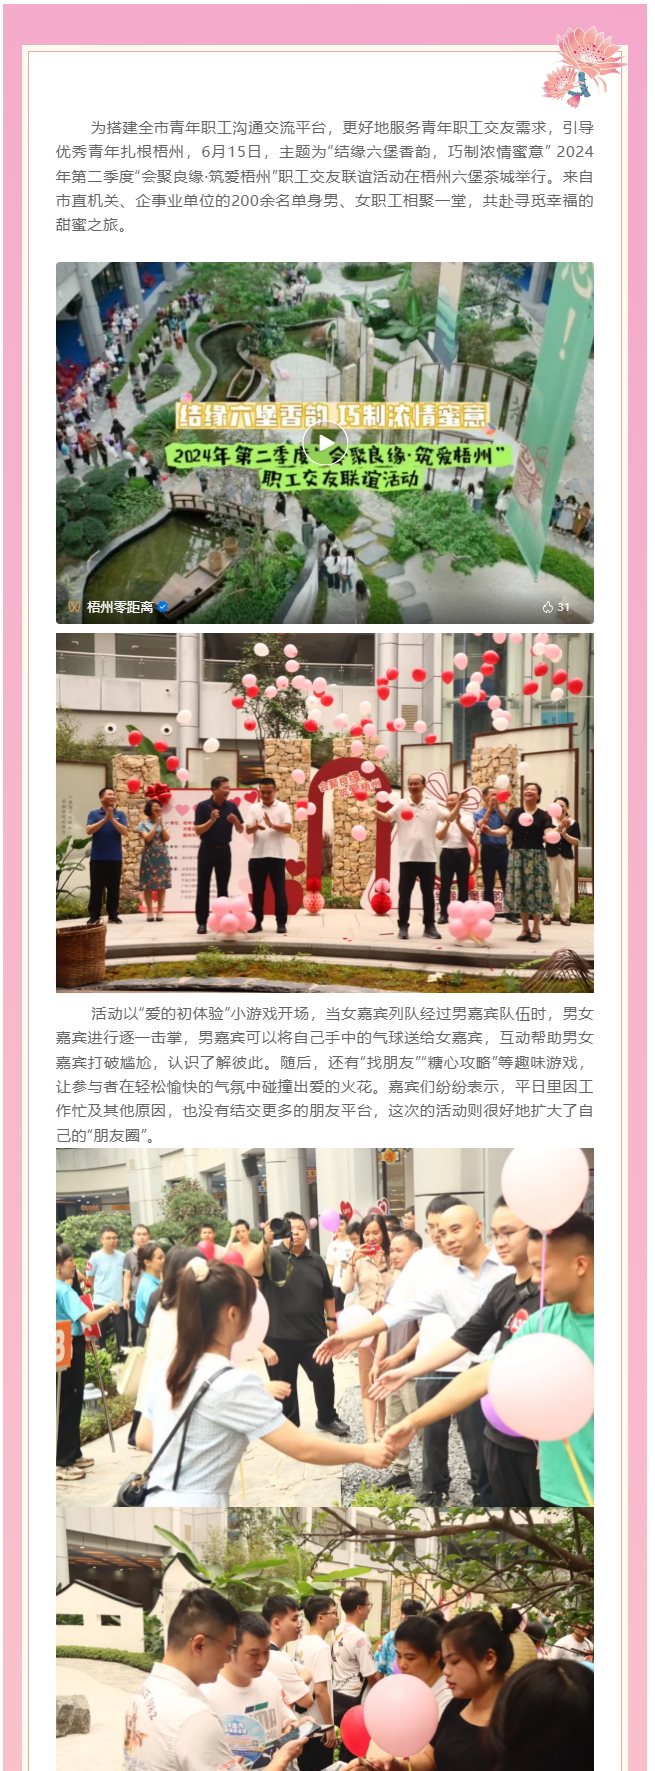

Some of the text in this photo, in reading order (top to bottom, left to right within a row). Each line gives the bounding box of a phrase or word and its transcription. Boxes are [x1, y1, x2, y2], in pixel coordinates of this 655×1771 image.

[91, 119, 594, 136] 为搭建全市青年职工沟通交流平台，更好地服务青年职工交友需求，引导
[556, 145, 594, 158] 2024
[55, 193, 594, 209] 市直机关、企事业单位的200余名单身男、女职工相聚一堂，共赴寻觅幸福的
[55, 217, 125, 233] 甜蜜之旅。
[91, 1006, 594, 1022] 活动以“爱的初体验”小游戏开场，当女嘉宾列队经过男嘉宾队伍时，男女
[55, 1029, 594, 1046] 嘉宾进行逐一击掌，男嘉宾可以将自己手中的气球送给女嘉宾，互动帮助男女
[55, 1078, 594, 1095] 让参与者在轻松愉快的气氛中碰撞出爱的火花。嘉宾们纷纷表示，平日里因工
[55, 1103, 593, 1119] 作忙及其他原因，也没有结交更多的朋友平台，这次的活动则很好地扩大了自
[56, 1128, 153, 1144] 己的“朋友圈”。
